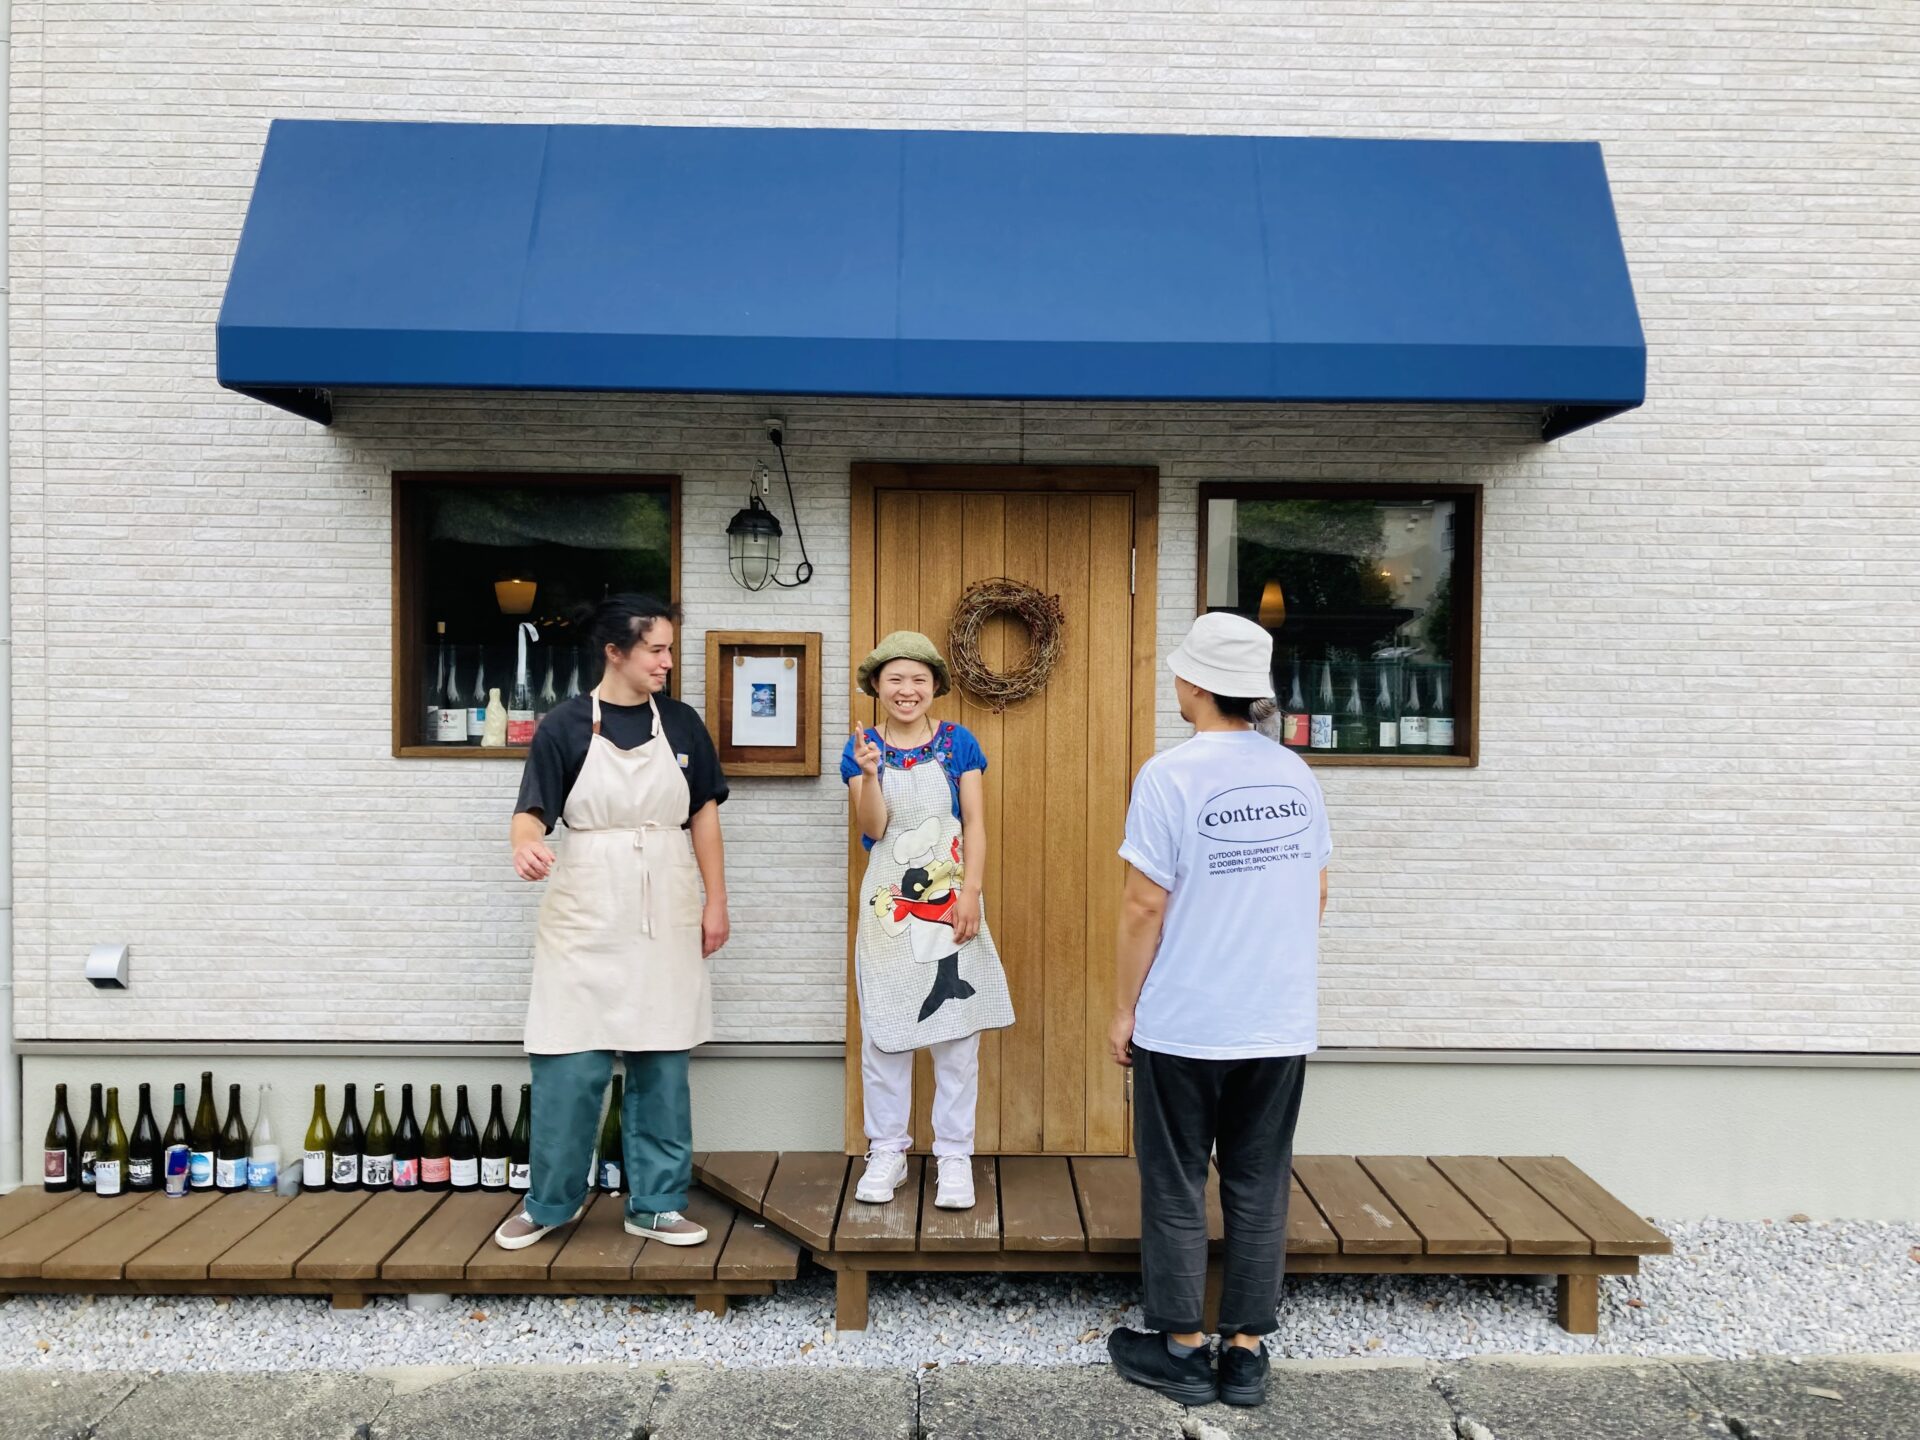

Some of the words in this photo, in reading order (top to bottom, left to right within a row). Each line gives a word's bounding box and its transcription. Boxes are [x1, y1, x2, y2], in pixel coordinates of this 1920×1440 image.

[1205, 799, 1307, 827] contrasto
[1208, 851, 1242, 860] OUTDOOR
[1243, 846, 1279, 856] EQUIPMENT
